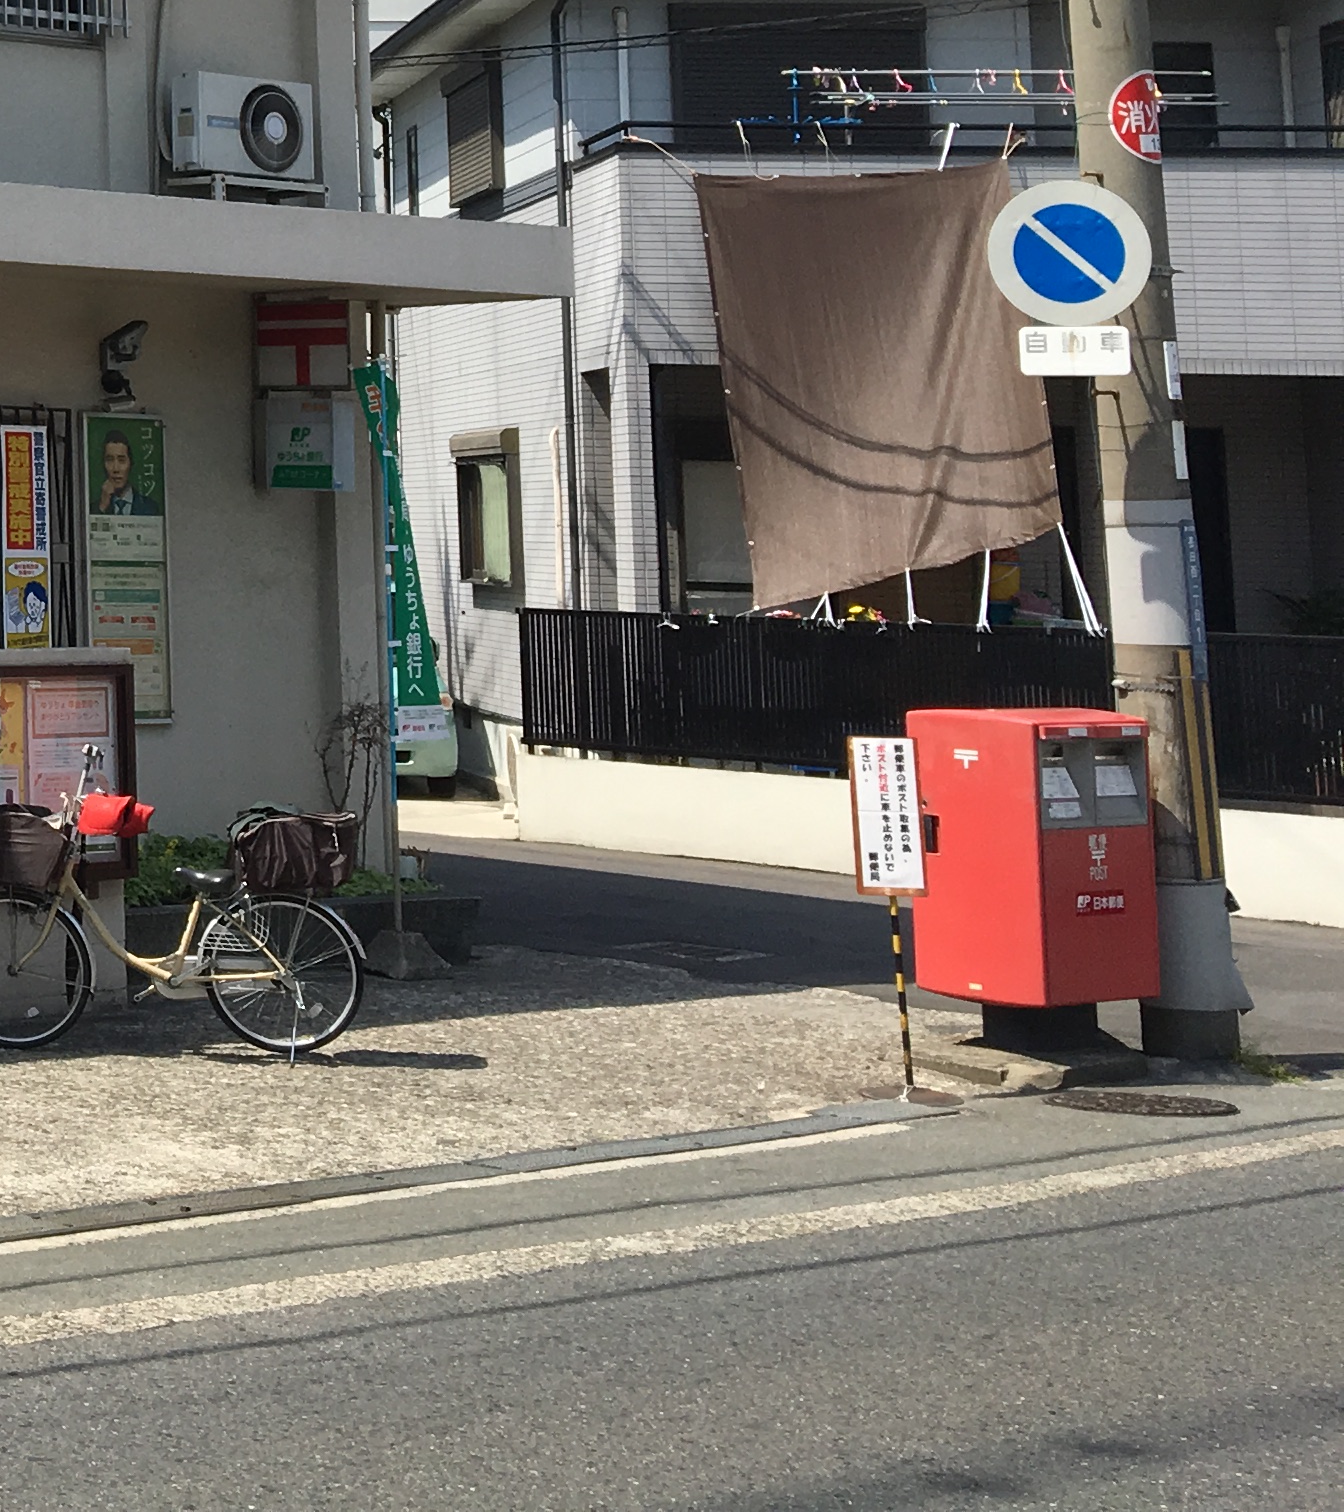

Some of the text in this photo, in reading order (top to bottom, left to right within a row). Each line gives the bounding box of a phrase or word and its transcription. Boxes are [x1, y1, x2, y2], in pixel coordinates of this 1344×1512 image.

[1025, 331, 1125, 354] 自動車
[1089, 865, 1108, 881] POST
[1093, 895, 1124, 910] 日本郵便
